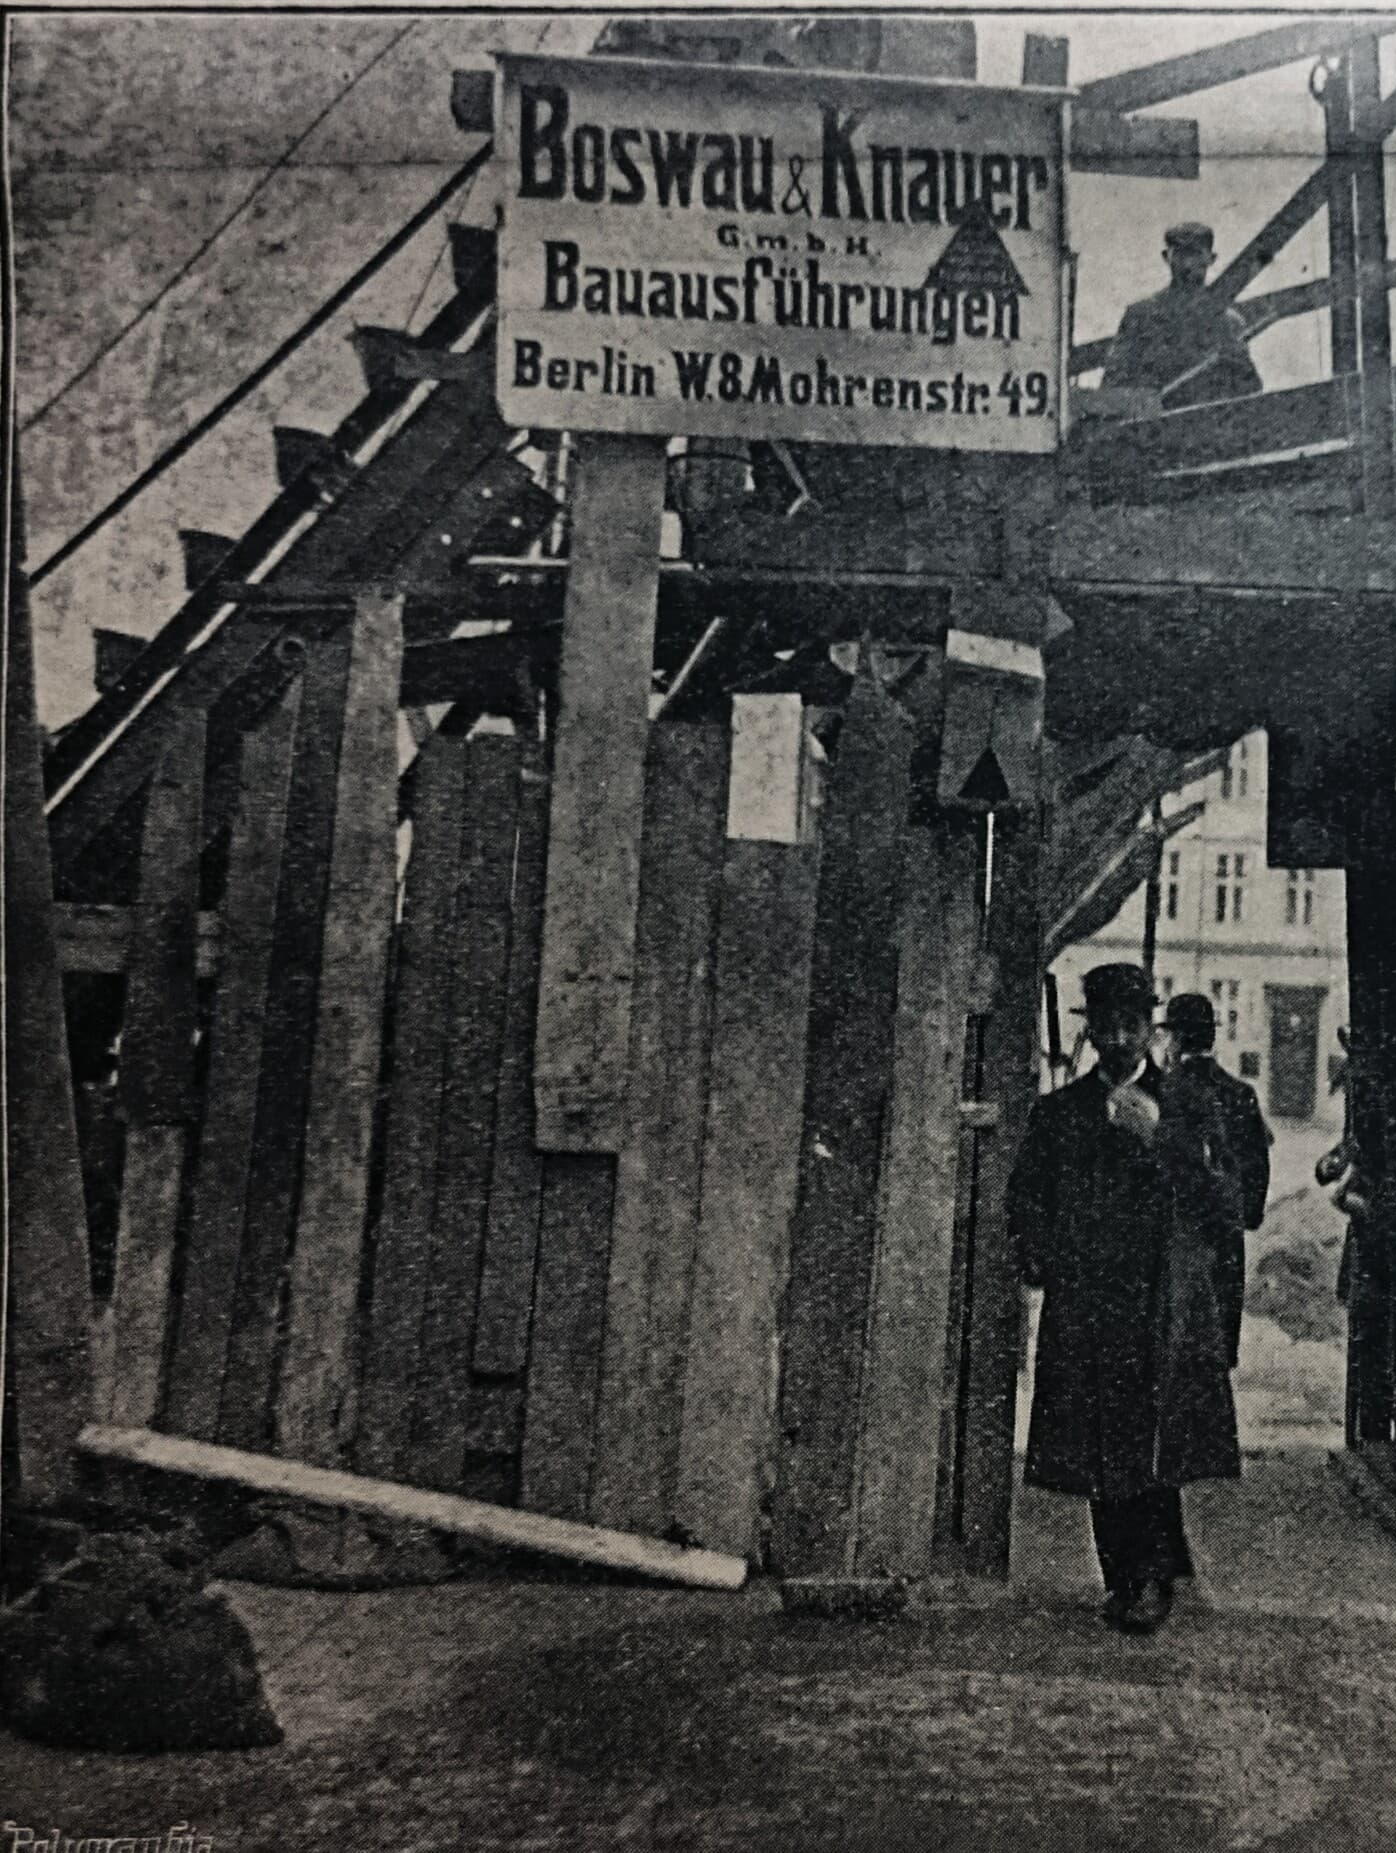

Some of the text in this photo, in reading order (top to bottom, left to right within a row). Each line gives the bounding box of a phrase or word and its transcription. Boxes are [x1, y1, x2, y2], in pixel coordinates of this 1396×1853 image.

[517, 83, 1052, 231] Boswau & Knauer
[541, 240, 1021, 345] Bauausführungen
[512, 338, 656, 398] Berlin
[748, 353, 990, 416] Mohrenstr.
